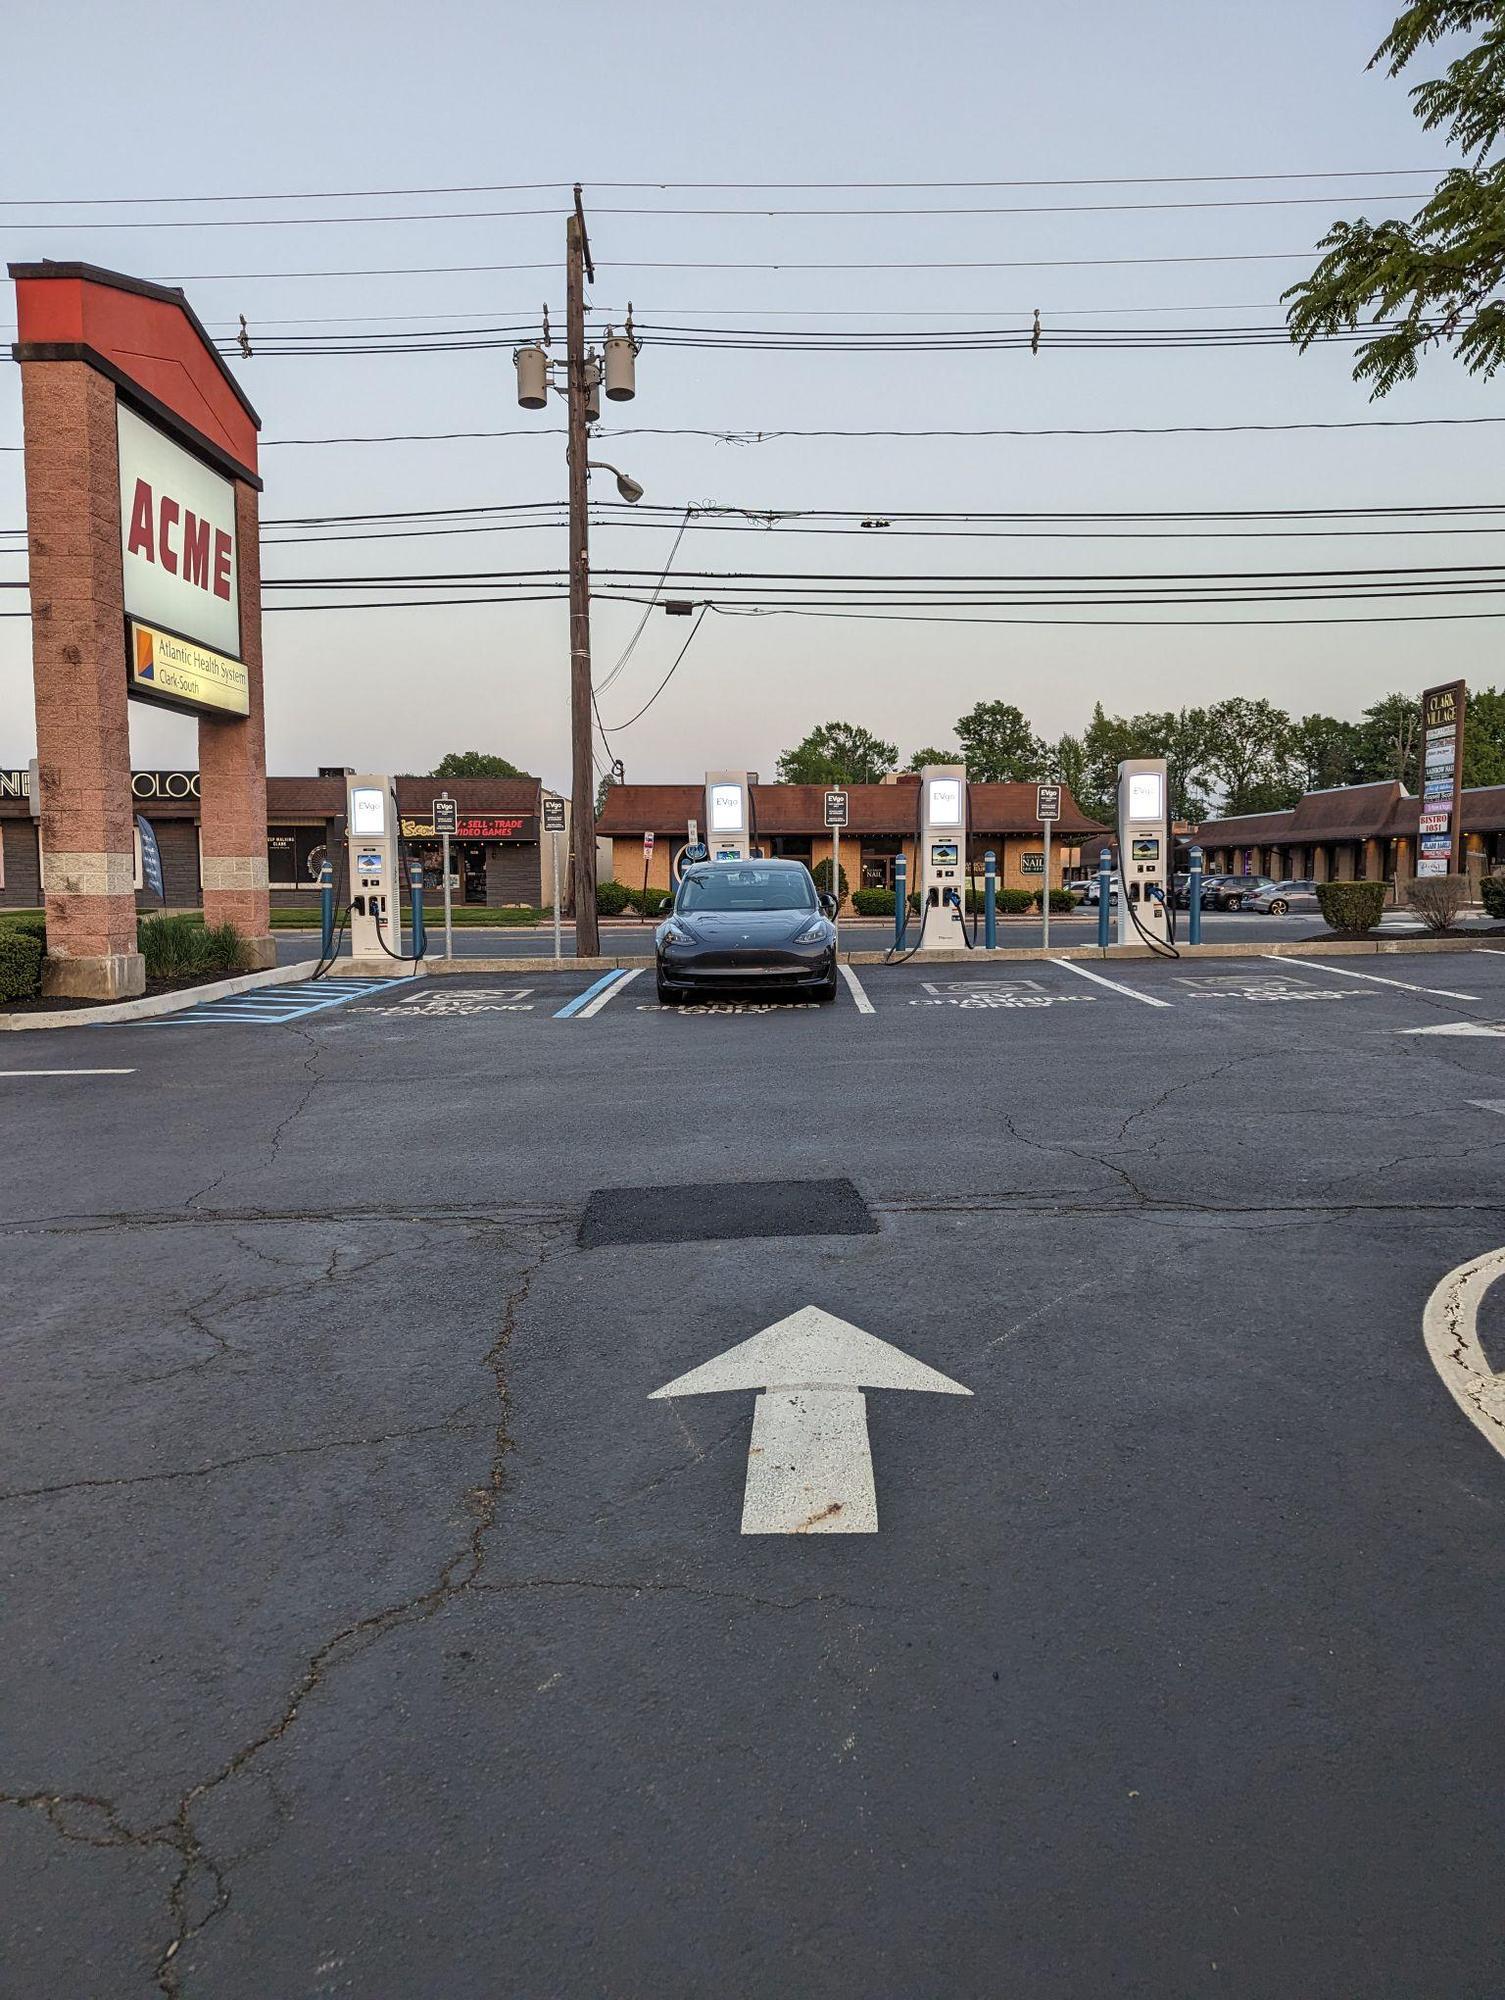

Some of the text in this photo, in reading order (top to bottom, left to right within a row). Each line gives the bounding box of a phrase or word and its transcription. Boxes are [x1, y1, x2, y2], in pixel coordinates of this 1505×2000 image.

[127, 477, 233, 602] ACME
[159, 639, 246, 685] Atlantic Health System
[159, 669, 200, 695] Clark-South
[1430, 692, 1454, 711] CLARK
[1427, 706, 1457, 725] VILLAGE
[933, 792, 956, 803] EVgo
[1041, 789, 1058, 797] EVgo
[716, 797, 738, 807] EVgo
[828, 795, 845, 803] EVgo
[359, 801, 382, 811] EVgo
[436, 803, 454, 811] EVgo
[546, 801, 563, 809] EVgo
[467, 820, 488, 828] SELL
[494, 820, 523, 828] TRADE
[1421, 815, 1447, 824] BISTRO
[482, 828, 513, 836] GAMES
[958, 1001, 1054, 1009] ONLY
